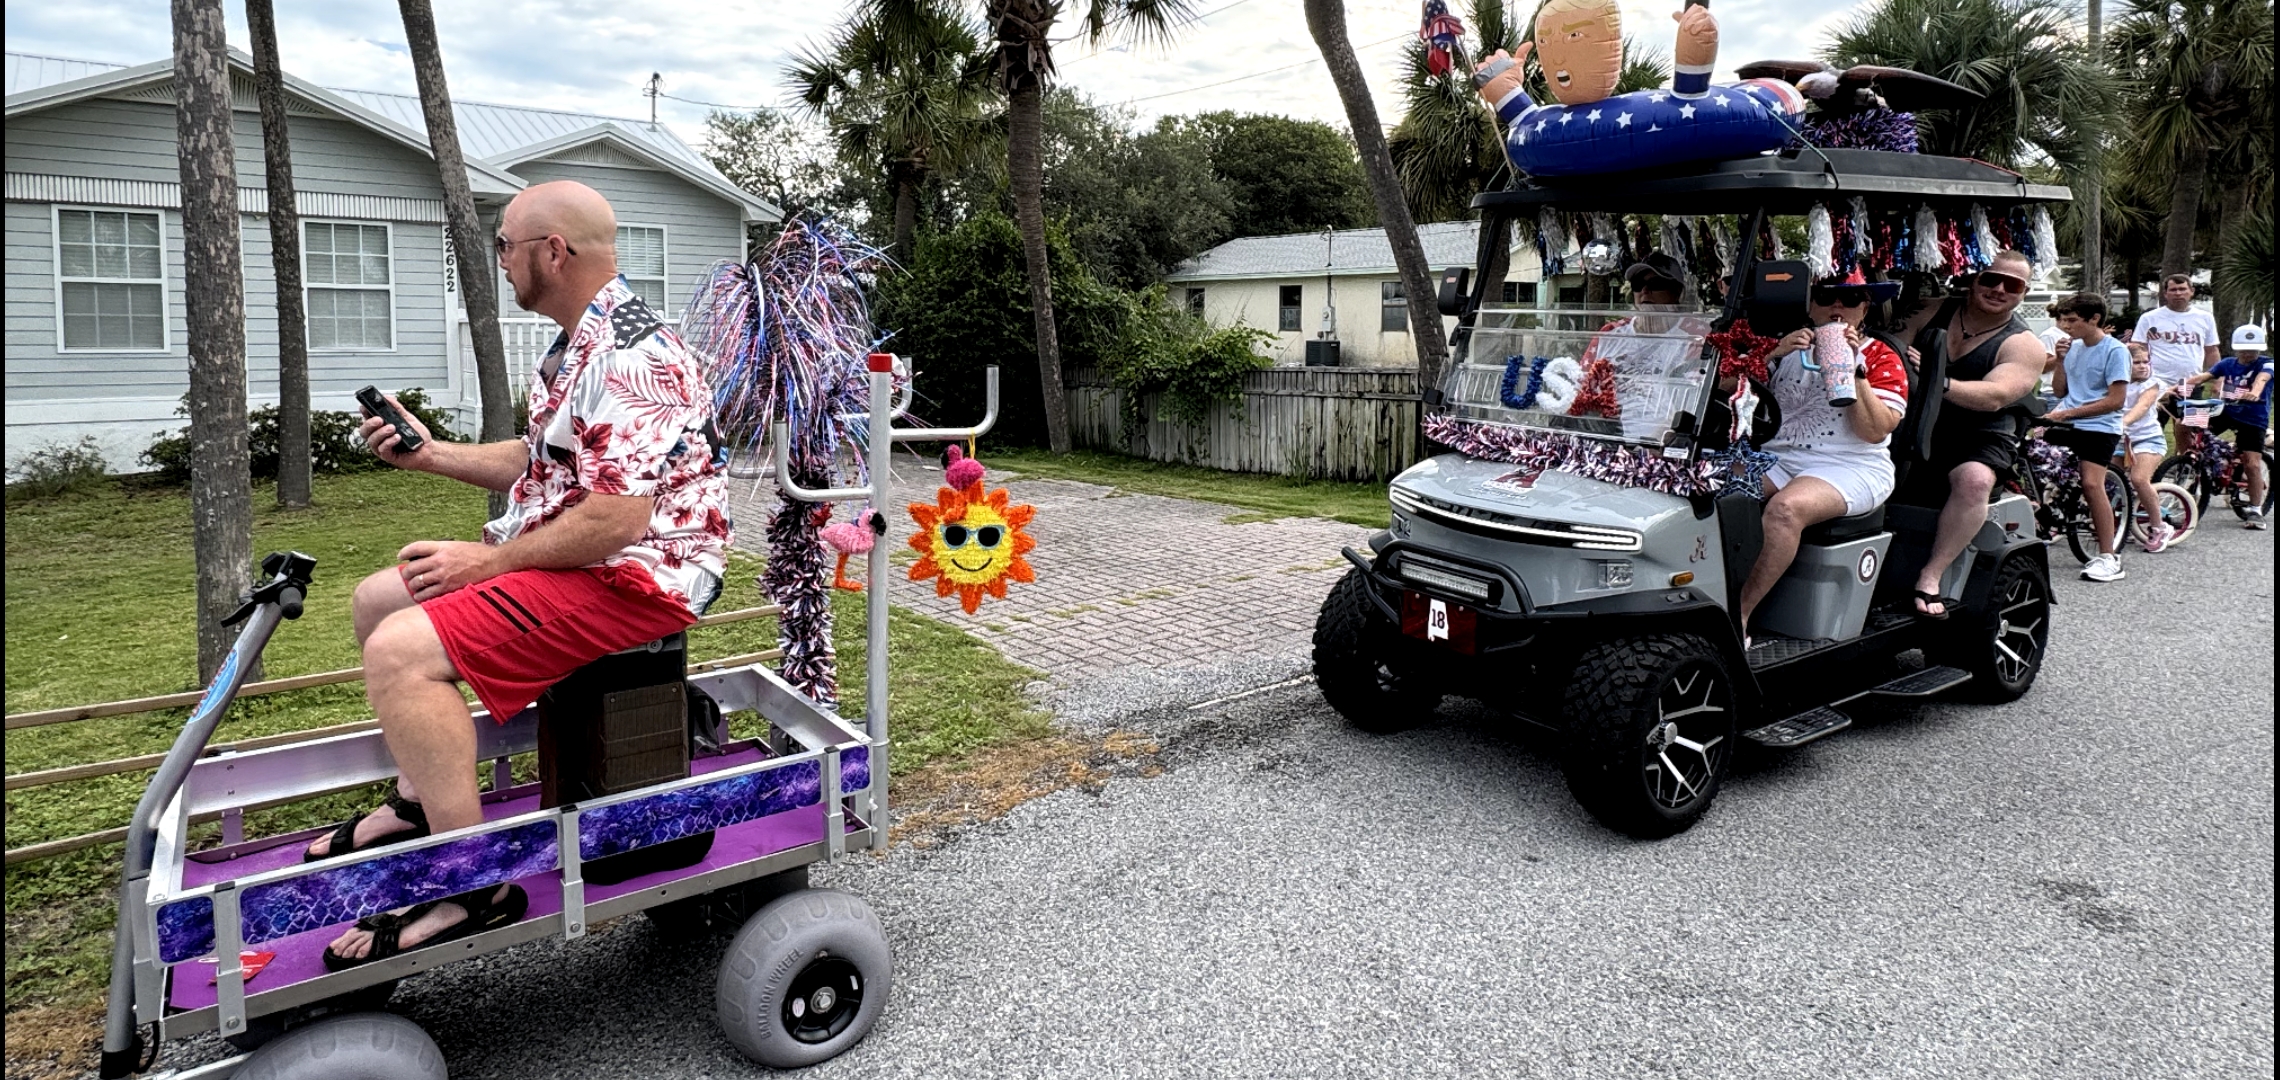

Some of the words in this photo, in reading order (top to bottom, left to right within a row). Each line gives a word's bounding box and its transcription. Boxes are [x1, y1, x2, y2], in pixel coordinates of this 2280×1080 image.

[444, 227, 455, 292] 22622
[1500, 354, 1618, 418] USA
[1431, 608, 1445, 629] 18
[758, 985, 776, 1040] BALLOON
[769, 946, 804, 983] WHEEL
